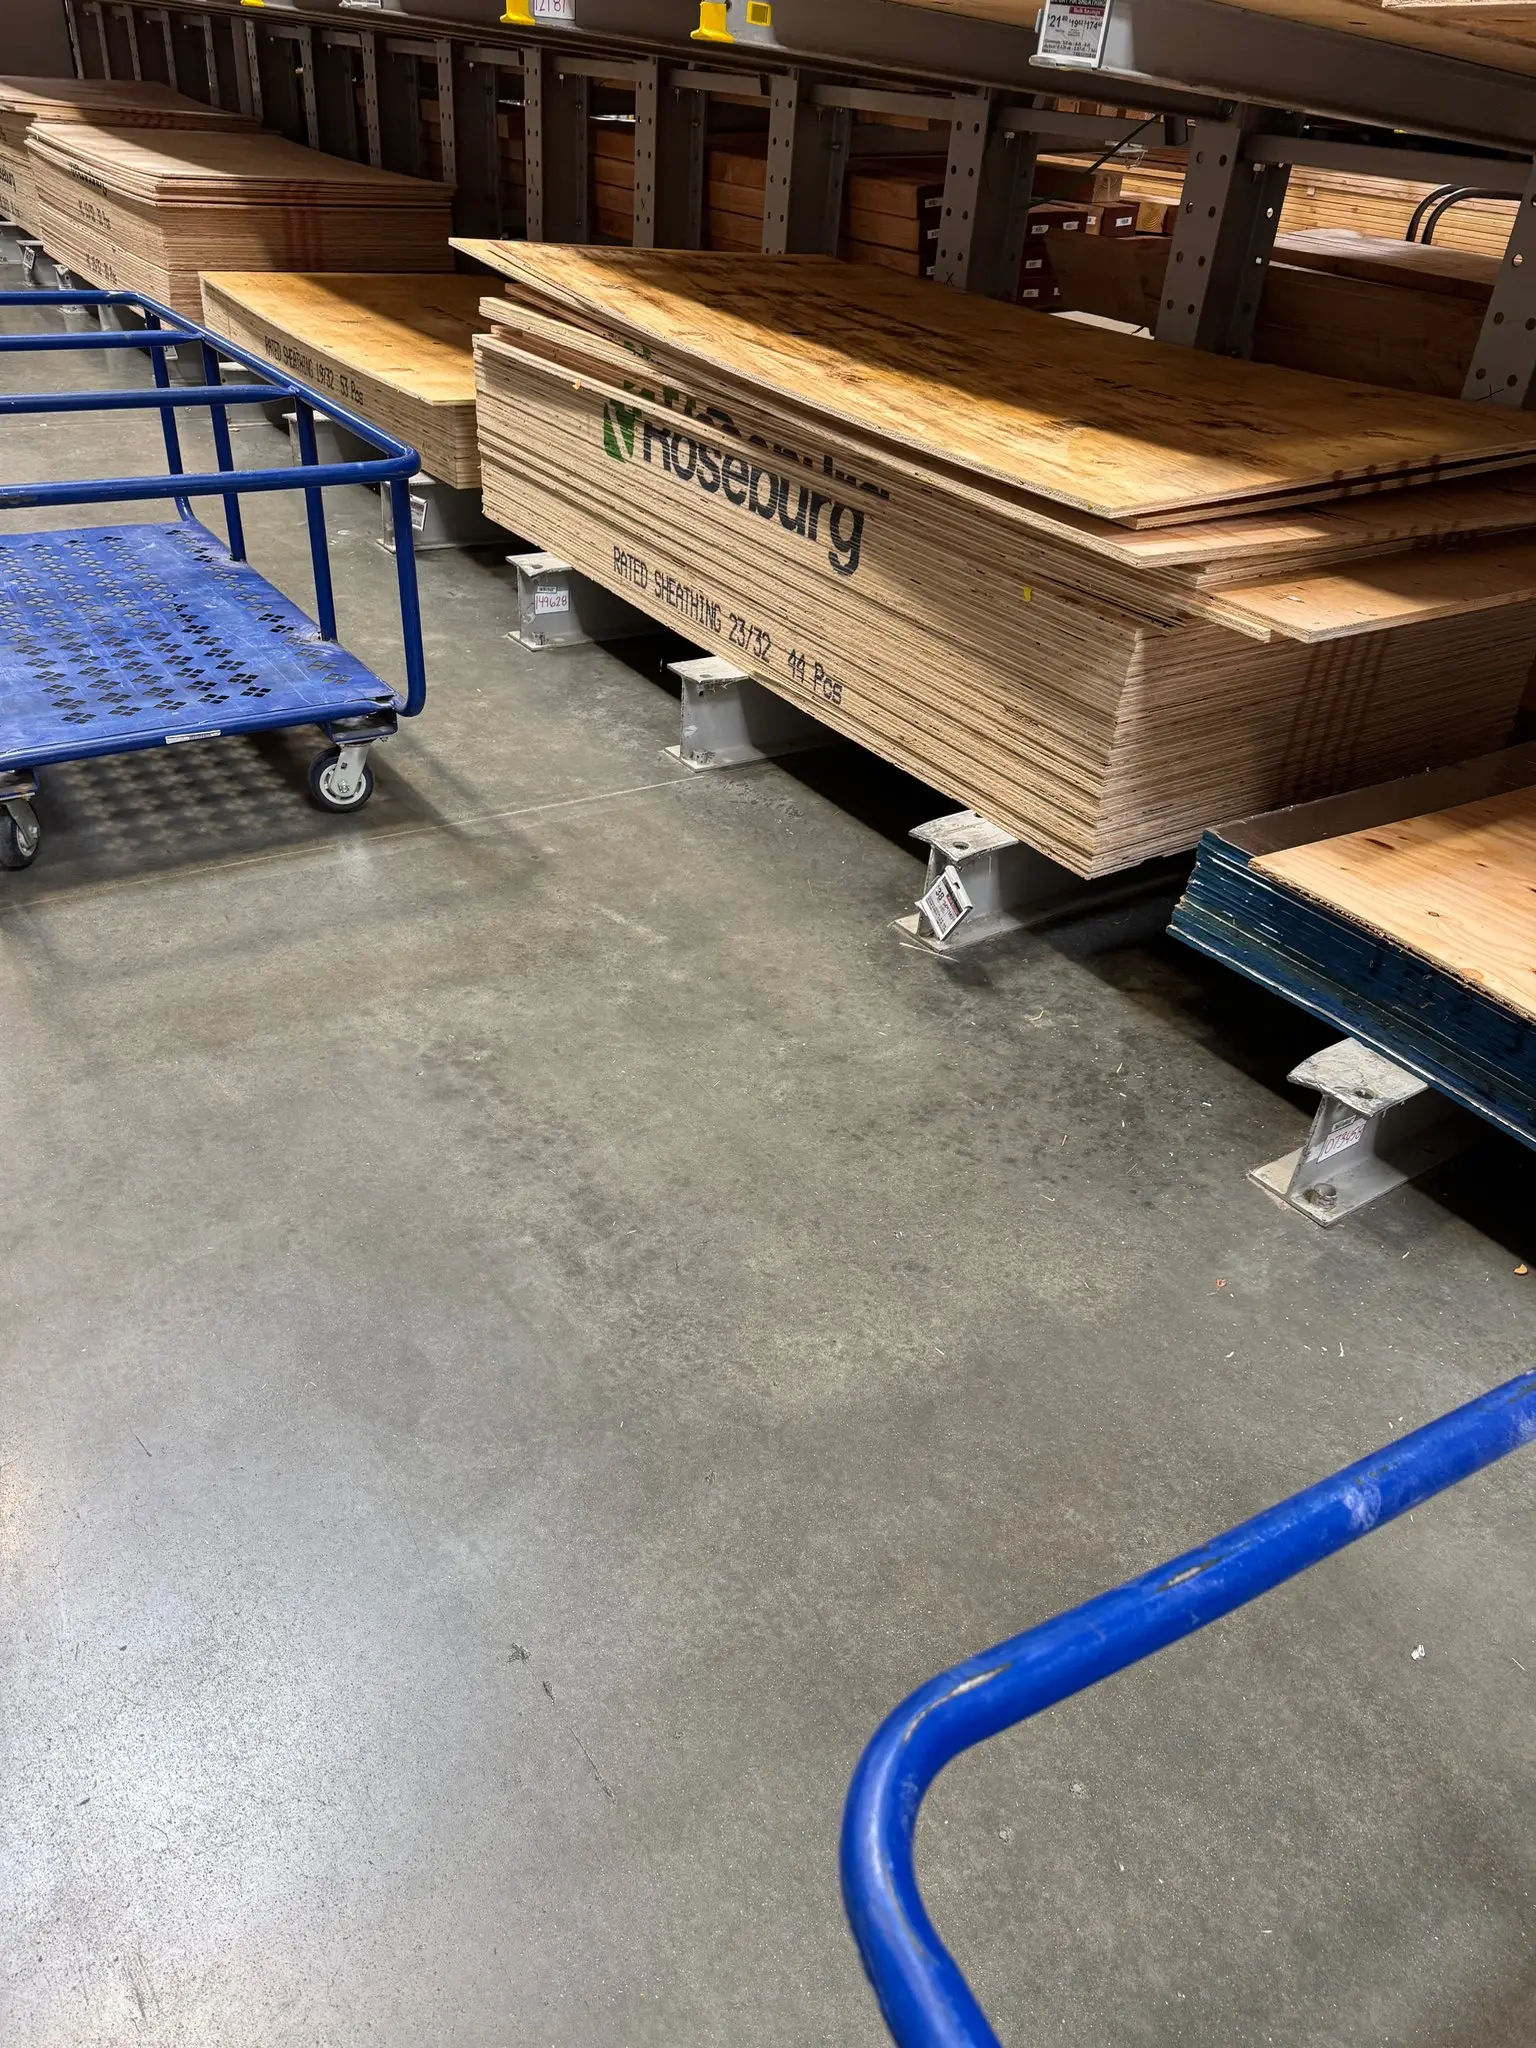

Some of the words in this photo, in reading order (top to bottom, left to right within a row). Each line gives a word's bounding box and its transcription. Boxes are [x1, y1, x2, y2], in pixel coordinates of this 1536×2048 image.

[643, 420, 866, 577] Roseburg
[613, 545, 649, 590] RATED
[654, 570, 722, 634] SHEATHING
[729, 612, 773, 664] 23/32
[788, 648, 807, 684] 44
[813, 661, 843, 705] Pcs
